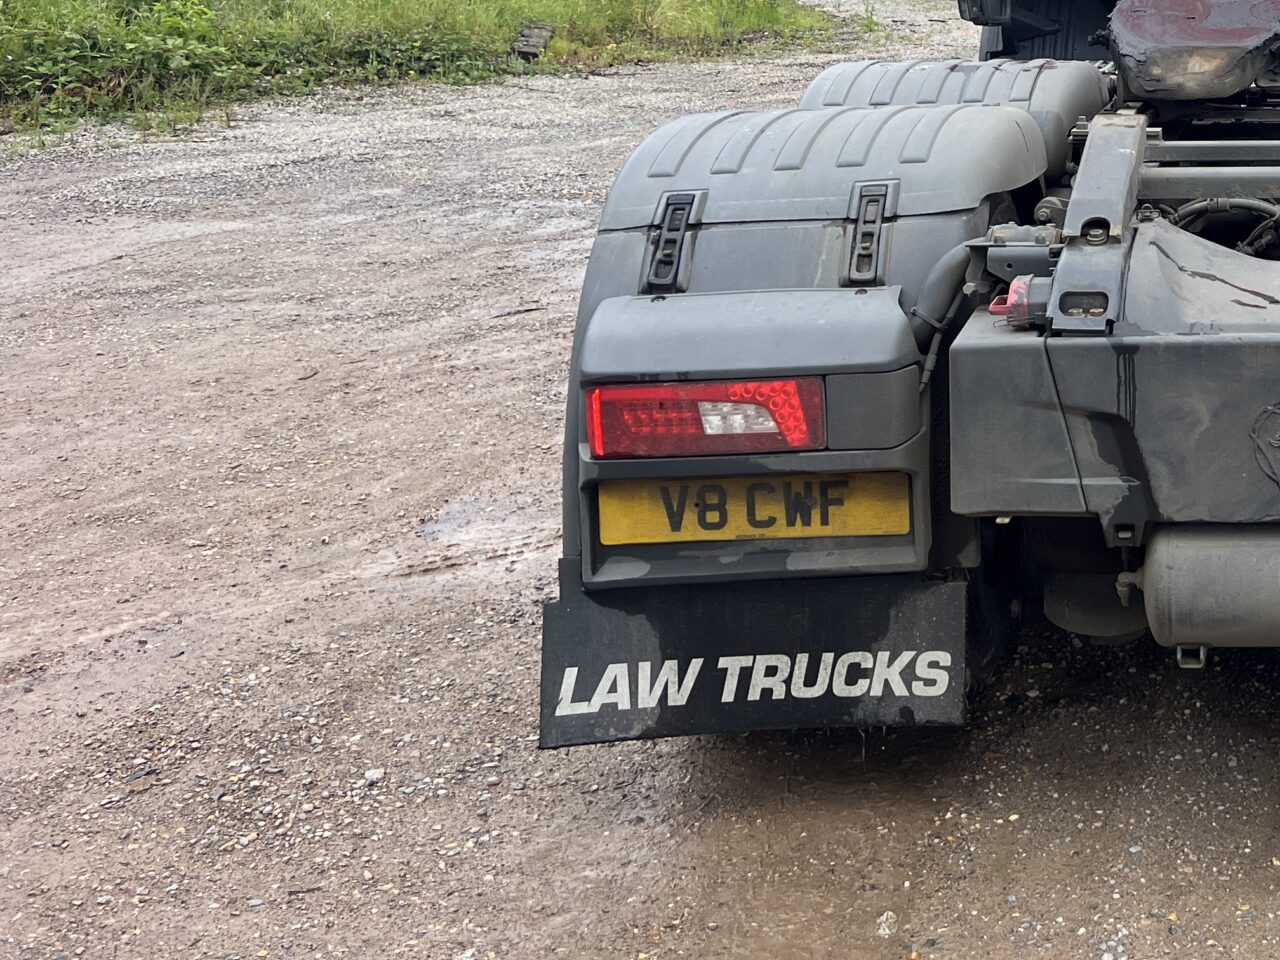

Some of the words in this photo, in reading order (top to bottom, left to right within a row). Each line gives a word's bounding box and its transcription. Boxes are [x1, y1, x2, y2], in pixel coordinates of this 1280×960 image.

[661, 486, 728, 532] V8
[747, 481, 846, 528] CWF
[555, 657, 704, 717] LAW
[717, 650, 952, 703] TRUCKS
